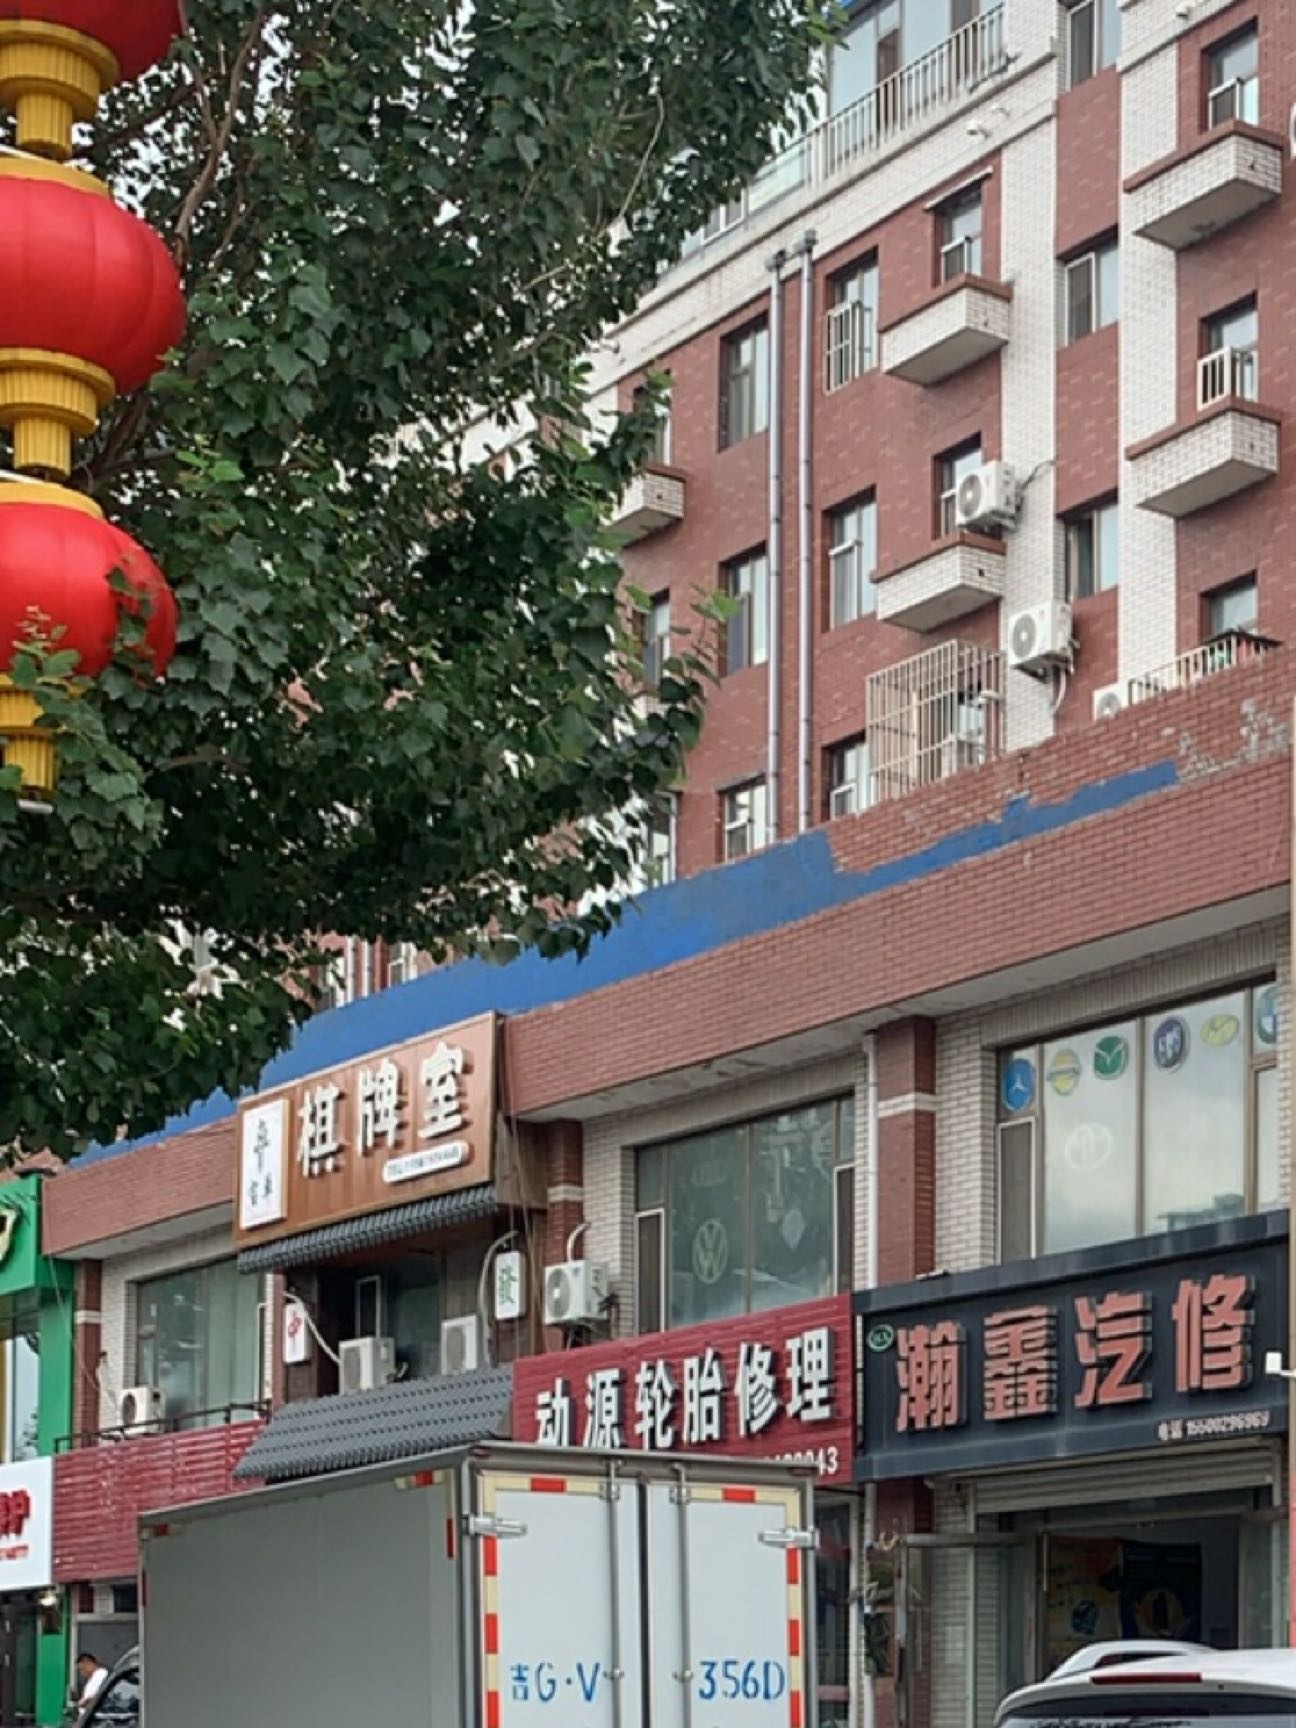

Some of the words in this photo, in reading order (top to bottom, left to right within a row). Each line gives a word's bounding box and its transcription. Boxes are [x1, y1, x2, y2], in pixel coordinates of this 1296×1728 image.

[296, 1041, 464, 1177] 棋牌室
[536, 1327, 832, 1449] 动源轮胎修理
[896, 1274, 1249, 1432] 瀚鑫汽修
[699, 1661, 786, 1700] 356D
